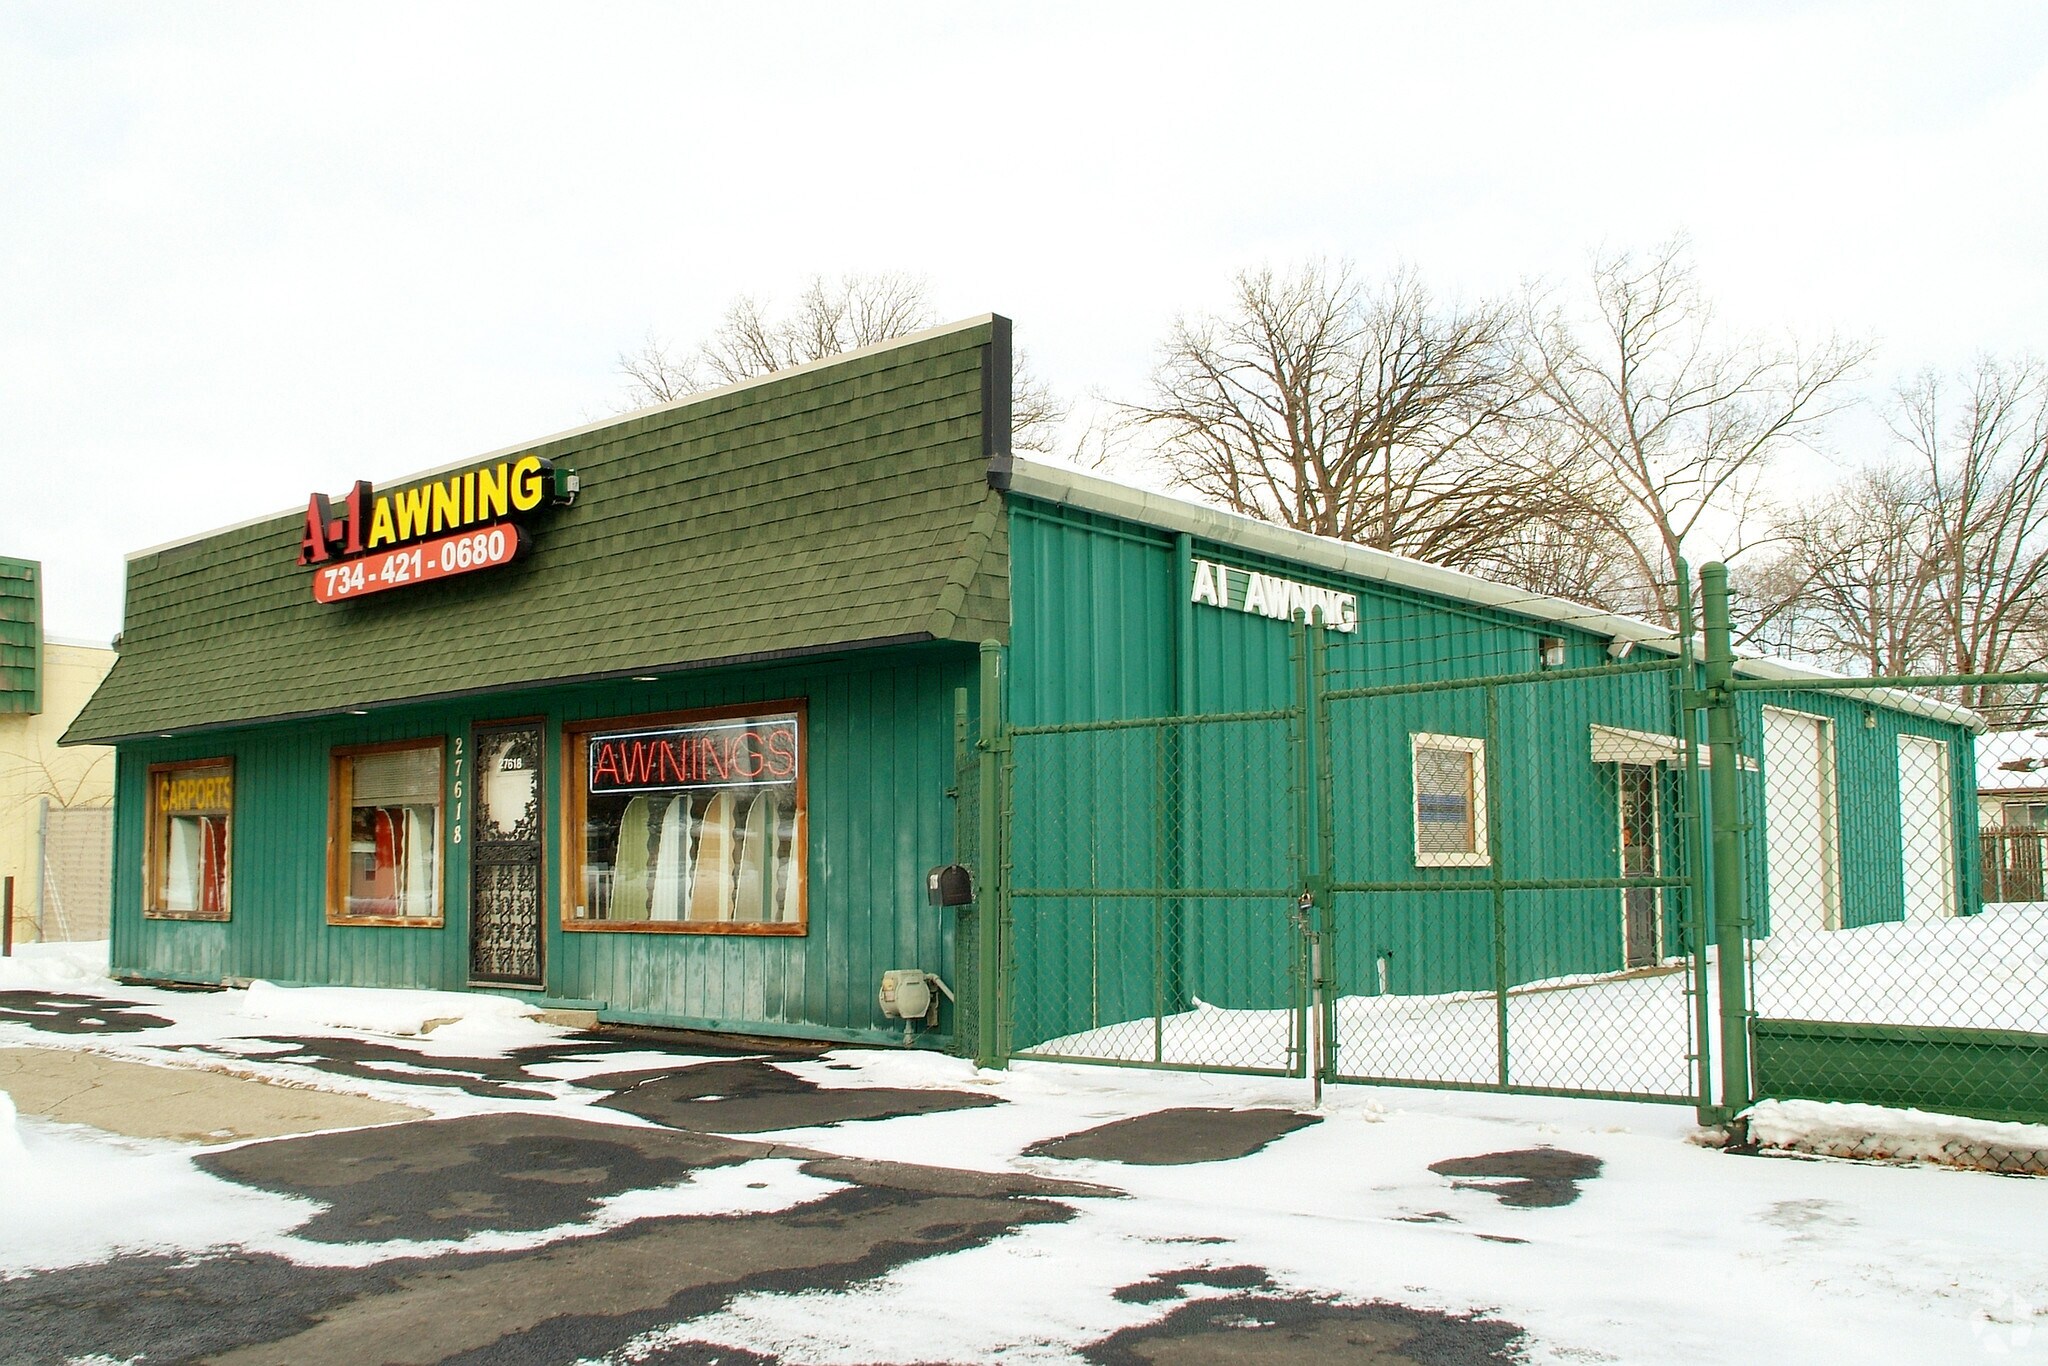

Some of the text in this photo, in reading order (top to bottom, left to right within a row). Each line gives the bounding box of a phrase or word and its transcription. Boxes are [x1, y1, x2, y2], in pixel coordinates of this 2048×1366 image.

[297, 456, 543, 565] A-1 AWNING
[1244, 572, 1355, 632] AWNING
[499, 757, 522, 770] 27618
[594, 730, 794, 784] AWNINGS
[160, 776, 231, 812] CARPORTS
[453, 737, 463, 844] 27618
